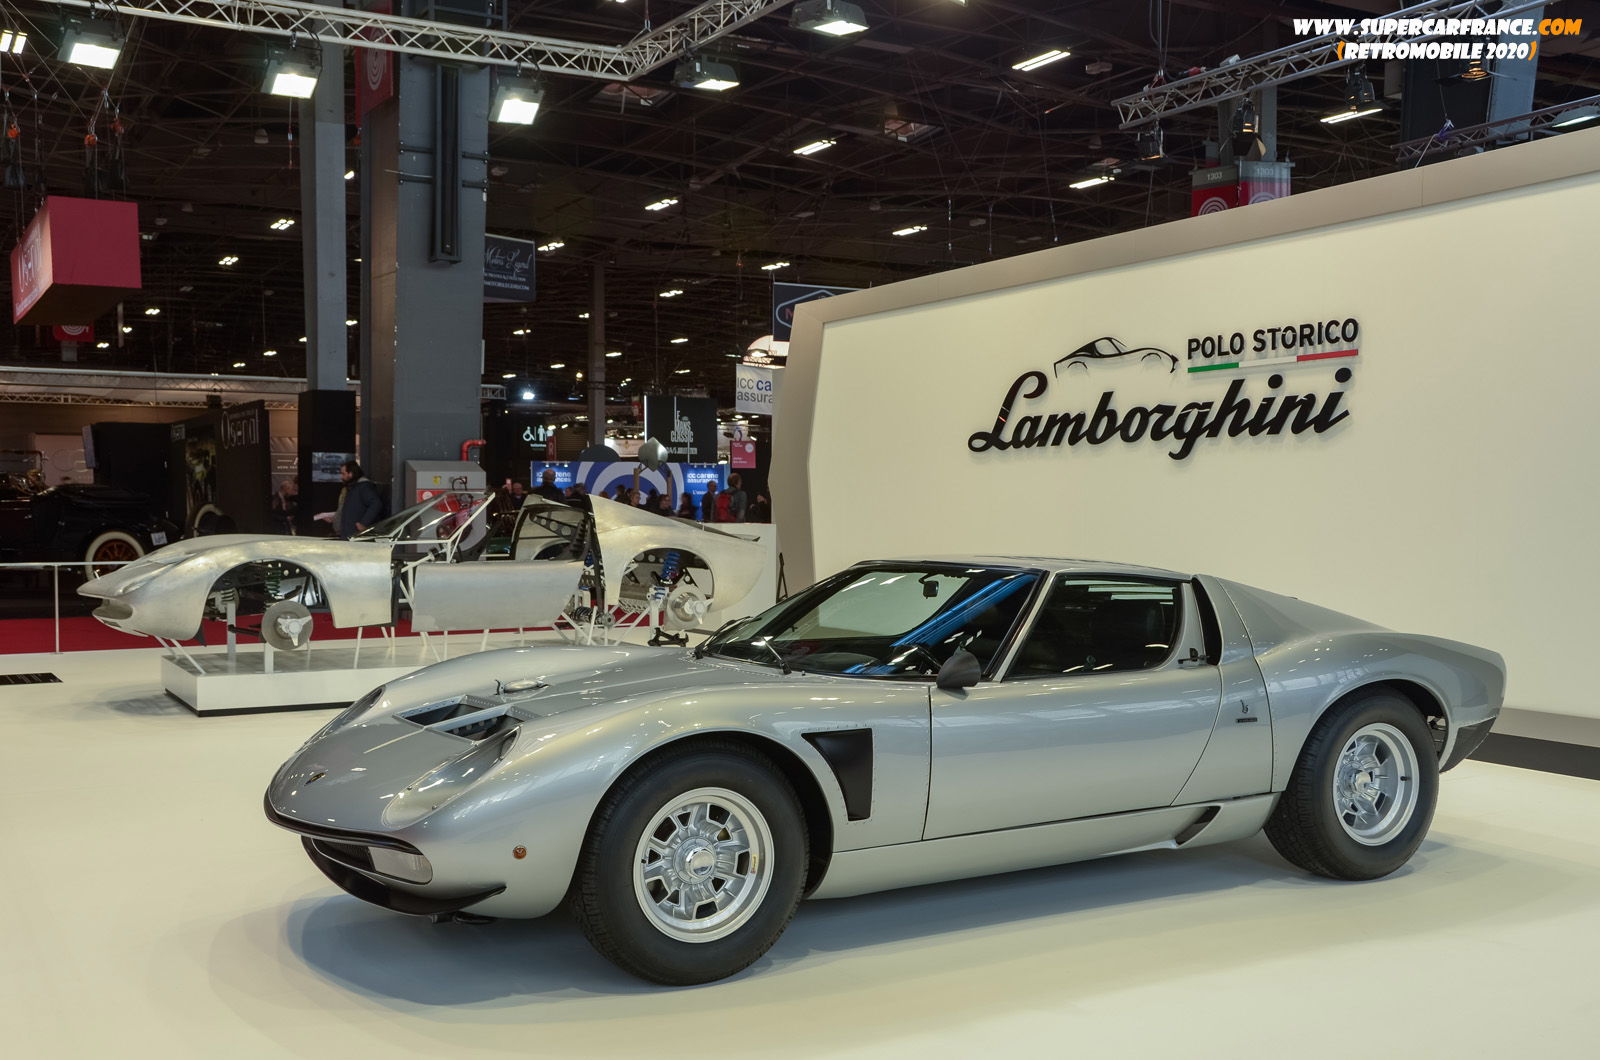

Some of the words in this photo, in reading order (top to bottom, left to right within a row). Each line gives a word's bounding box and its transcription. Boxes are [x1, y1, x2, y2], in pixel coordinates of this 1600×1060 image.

[1207, 171, 1223, 181] 1303
[1256, 168, 1274, 176] 1303
[1187, 332, 1245, 360] POLO
[1252, 318, 1359, 352] STORICO
[968, 367, 1352, 460] Lamborghini
[671, 431, 694, 443] CLASSIC
